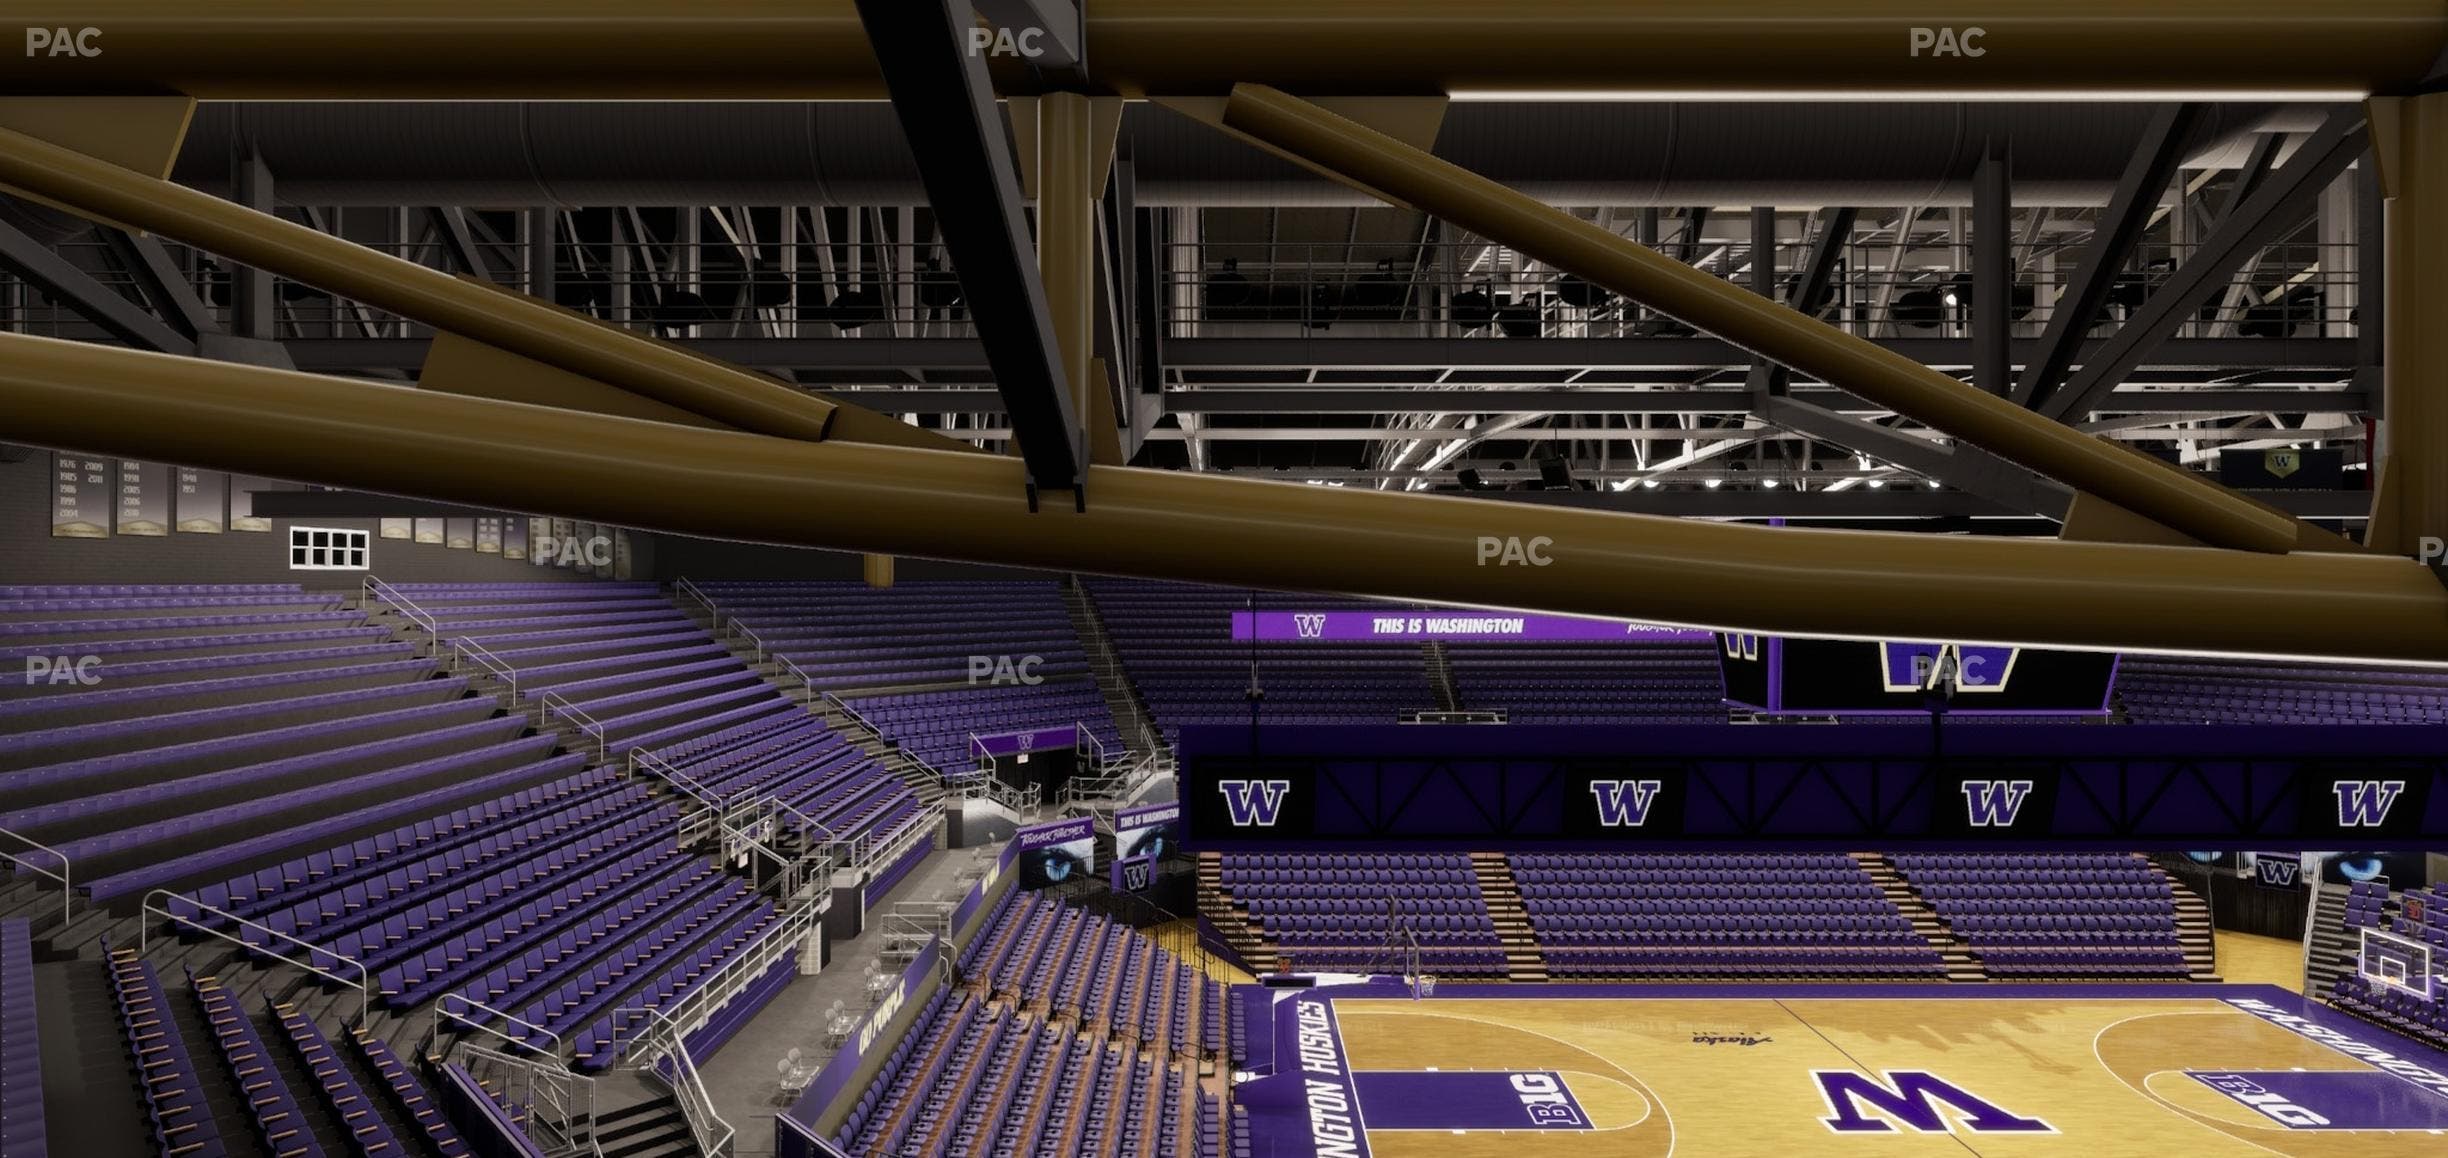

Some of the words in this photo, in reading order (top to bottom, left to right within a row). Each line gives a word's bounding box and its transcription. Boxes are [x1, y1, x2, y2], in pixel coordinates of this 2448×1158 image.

[1294, 614, 1326, 638] W
[1373, 618, 1404, 634] THIS
[1408, 618, 1422, 634] IS
[1425, 618, 1525, 634] WASHINGTON
[1219, 780, 1290, 826] W
[1590, 780, 1661, 826] W
[1961, 780, 2033, 826] W
[2332, 780, 2405, 827] W
[1124, 863, 1149, 890] W
[2257, 859, 2299, 885] W
[1297, 1001, 1340, 1076] HUSKIES
[1305, 1078, 1359, 1158] NGTON
